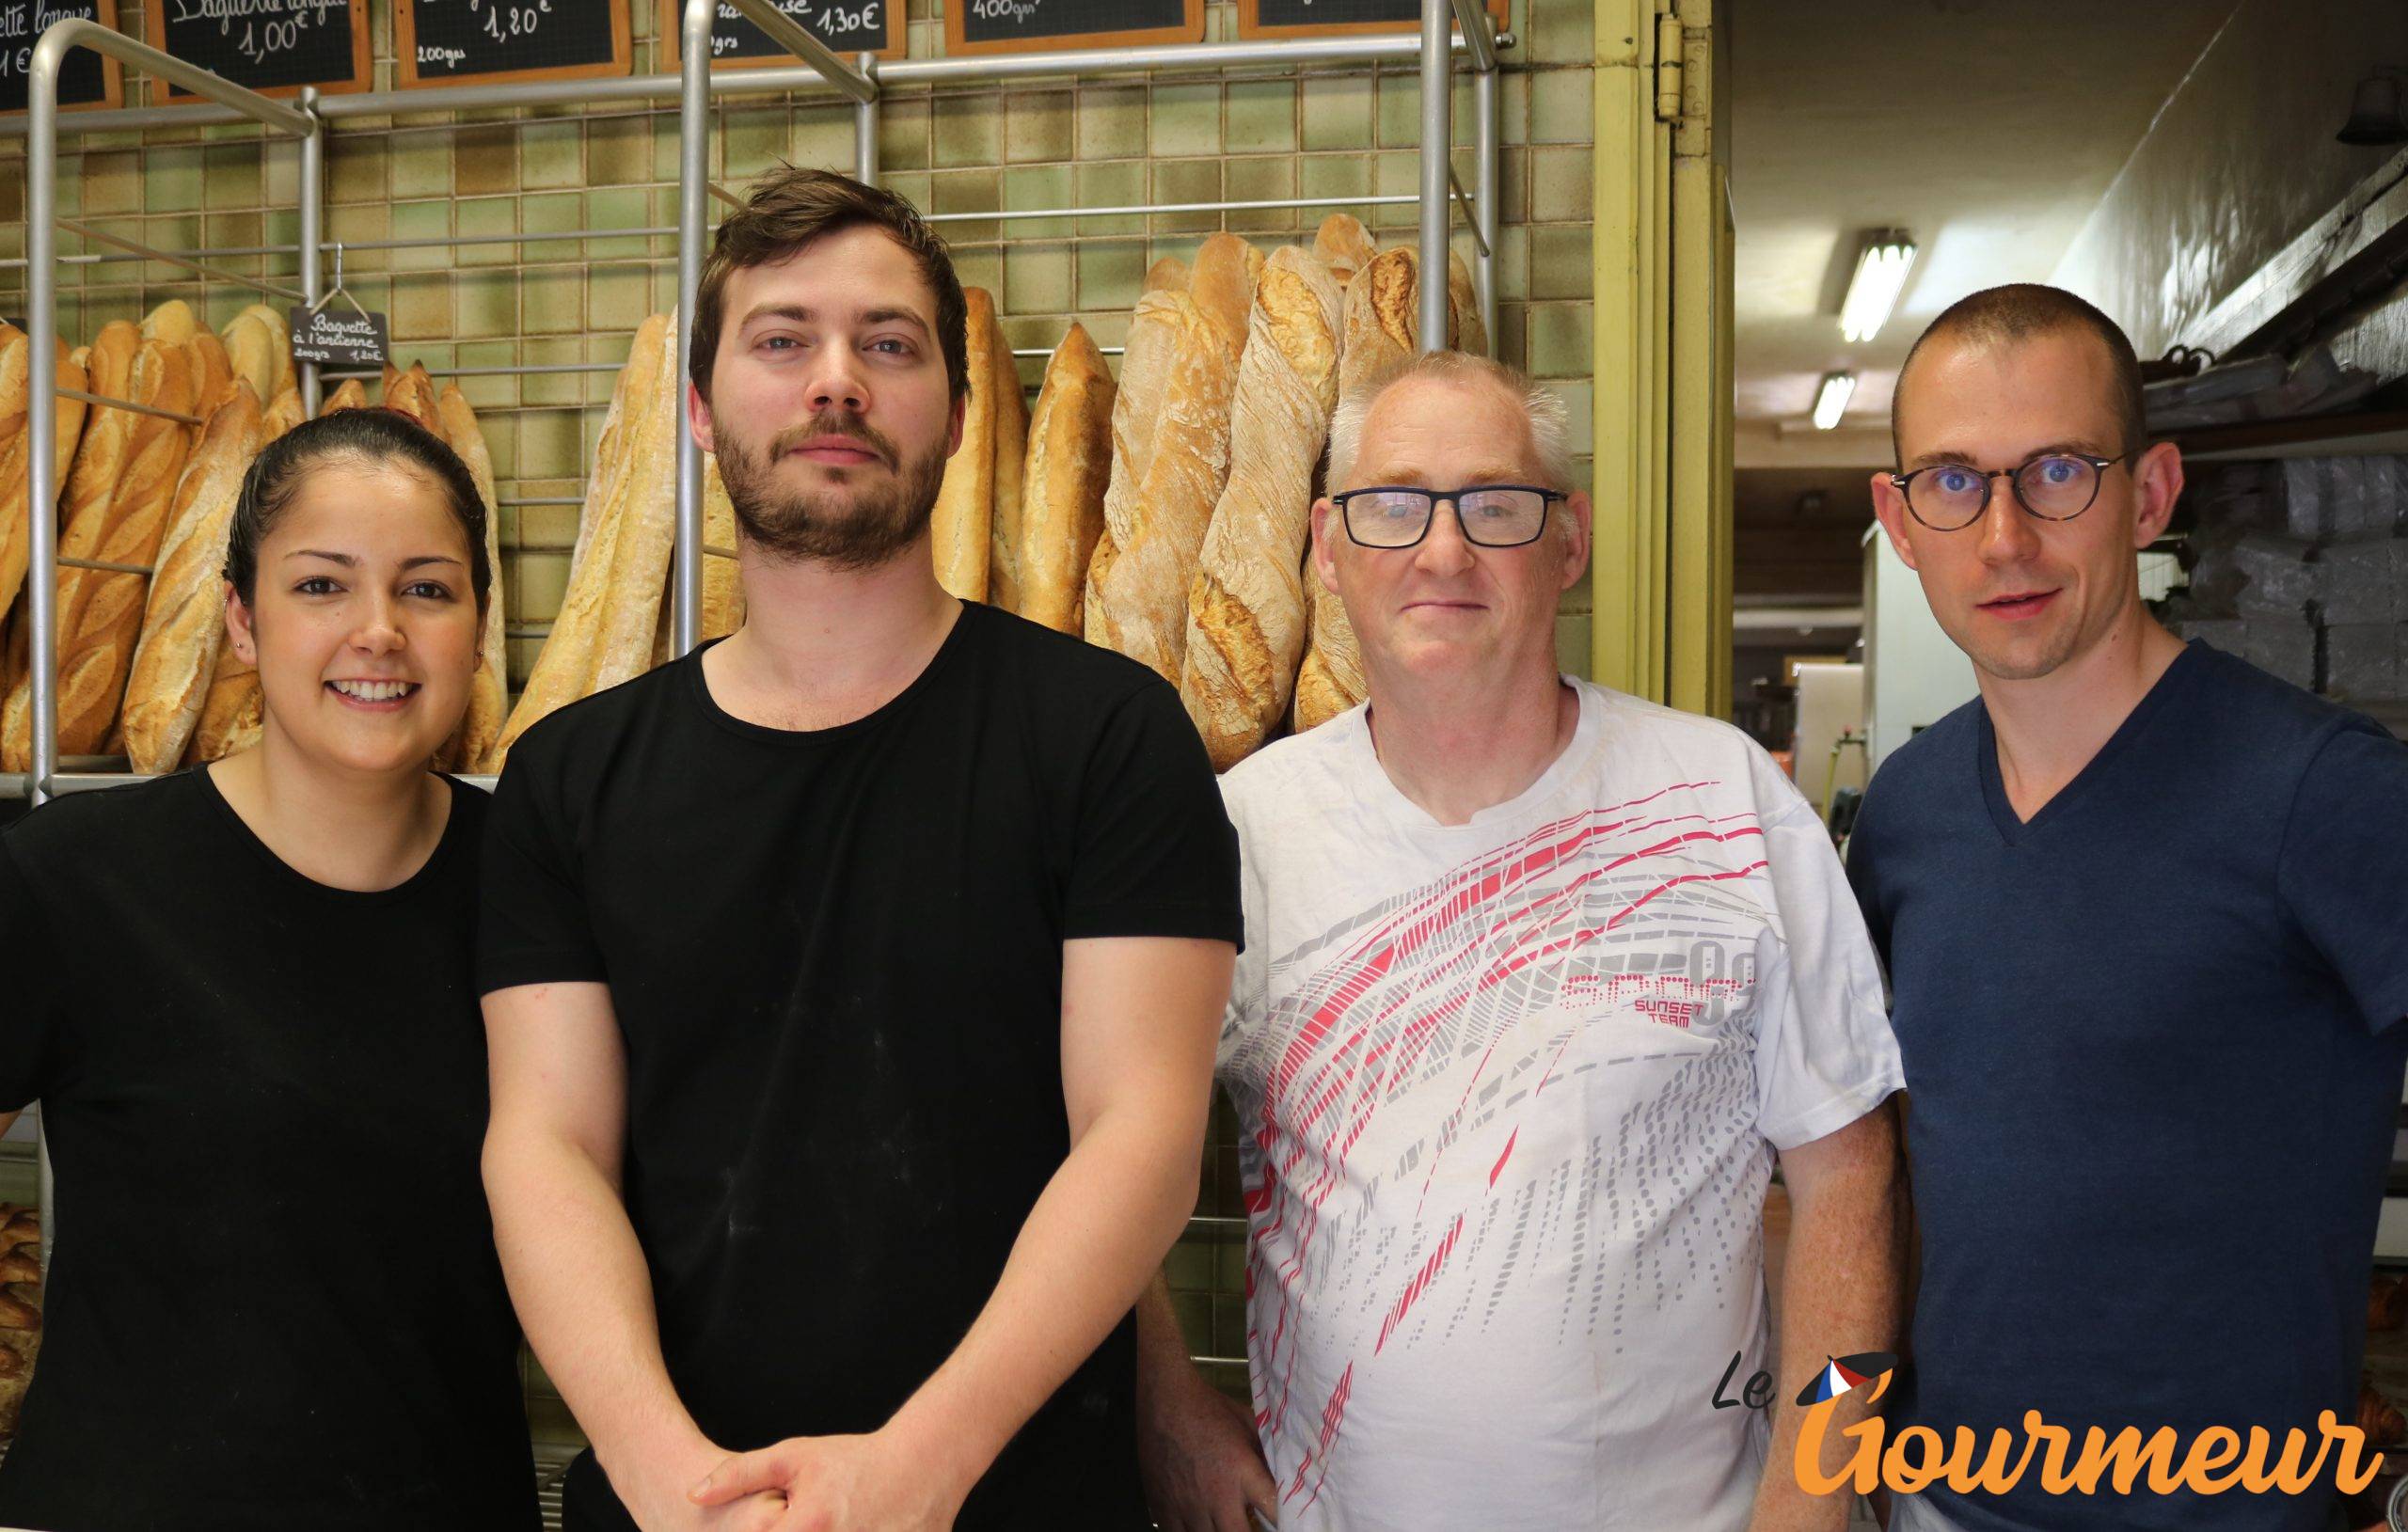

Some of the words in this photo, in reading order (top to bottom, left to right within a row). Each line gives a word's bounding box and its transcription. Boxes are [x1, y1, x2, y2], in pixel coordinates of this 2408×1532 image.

[816, 3, 880, 36] 1,30€
[310, 313, 378, 337] Baguette
[293, 329, 305, 344] à
[1634, 1000, 1704, 1017] SUNSET
[1648, 1013, 1690, 1029] TEAM
